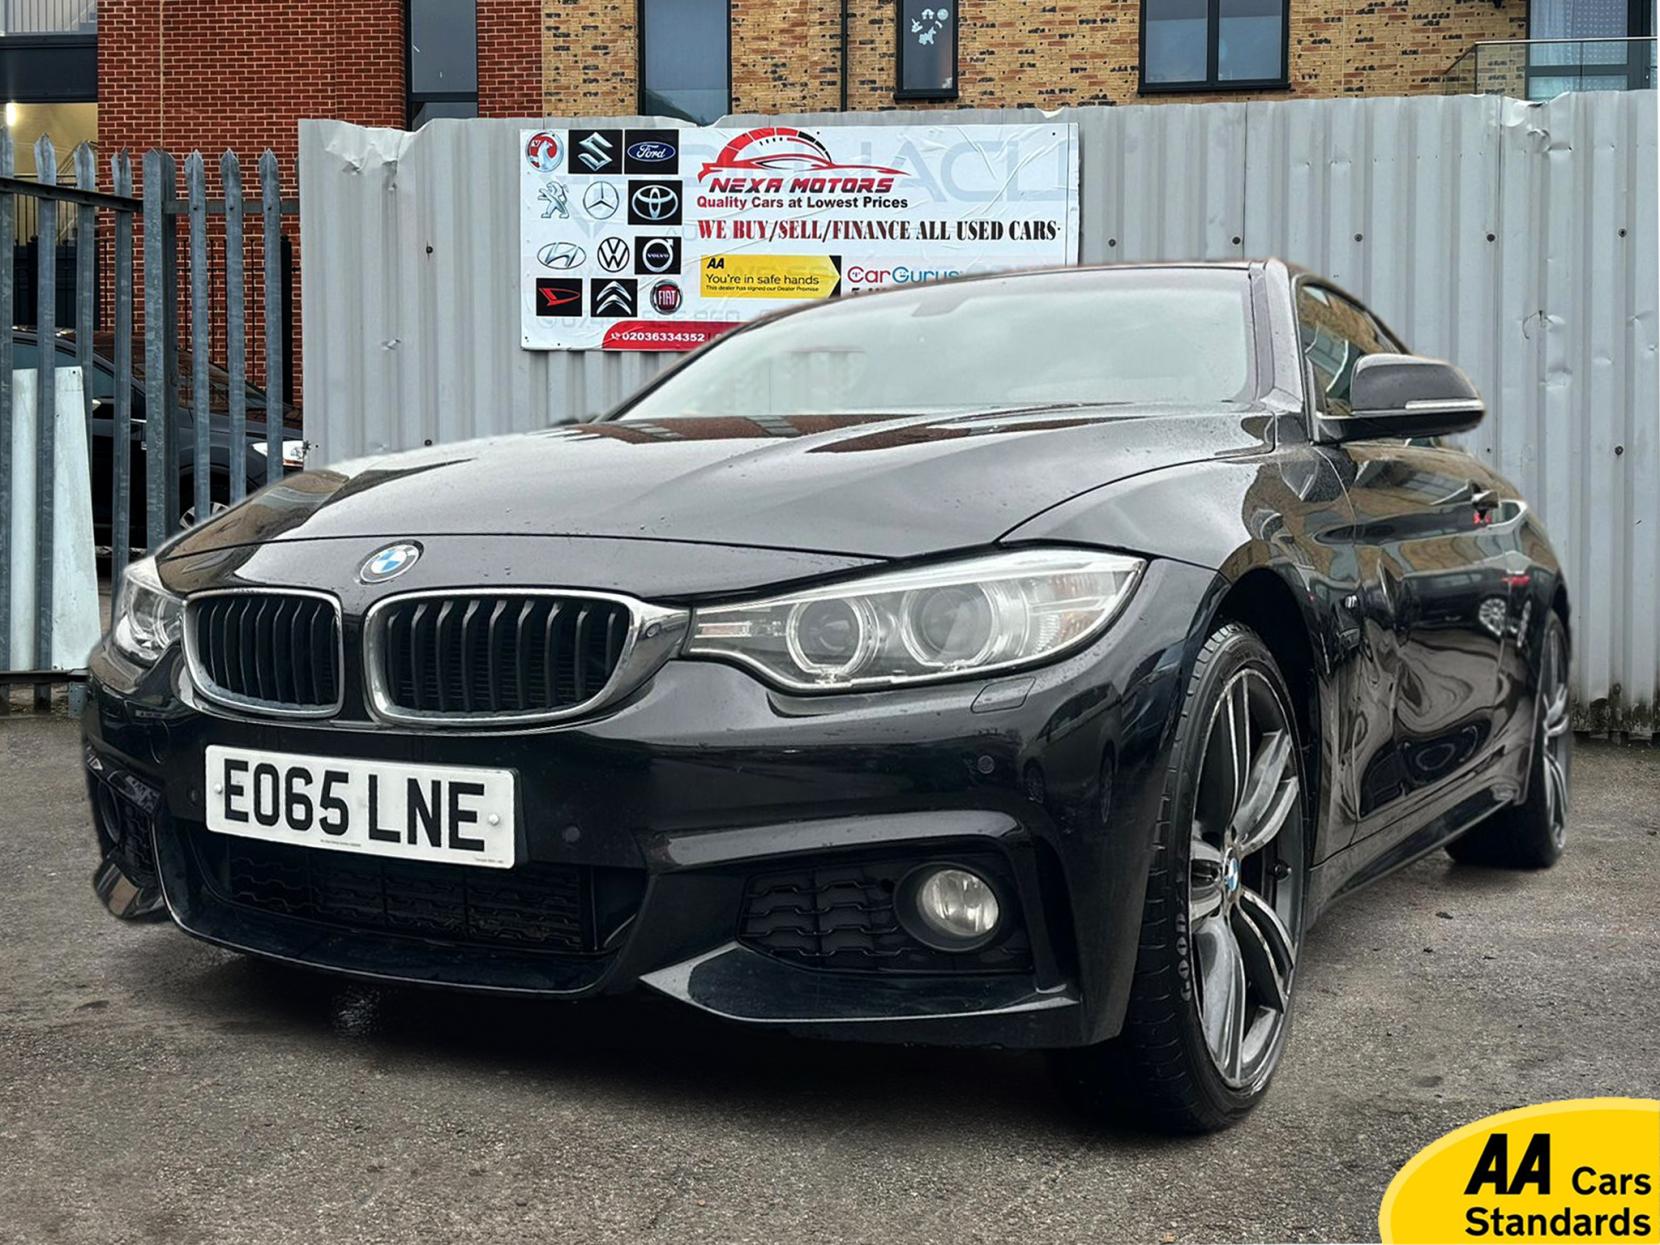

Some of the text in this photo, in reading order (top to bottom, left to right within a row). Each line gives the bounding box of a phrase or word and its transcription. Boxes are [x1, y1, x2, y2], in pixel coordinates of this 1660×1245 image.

[636, 144, 665, 159] Ford
[708, 177, 894, 193] NEXA MOTORS
[697, 195, 908, 210] Quality Cars at Lowest Prices
[697, 220, 727, 239] WE
[732, 219, 911, 242] BUY/SELL/FINANCE
[915, 220, 951, 240] ALL
[956, 220, 1004, 240] USED
[706, 257, 725, 269] AA
[705, 273, 820, 285] You're in safe hands
[658, 290, 676, 305] FIAT
[622, 332, 705, 342] 02036334352
[368, 773, 485, 852] LNE
